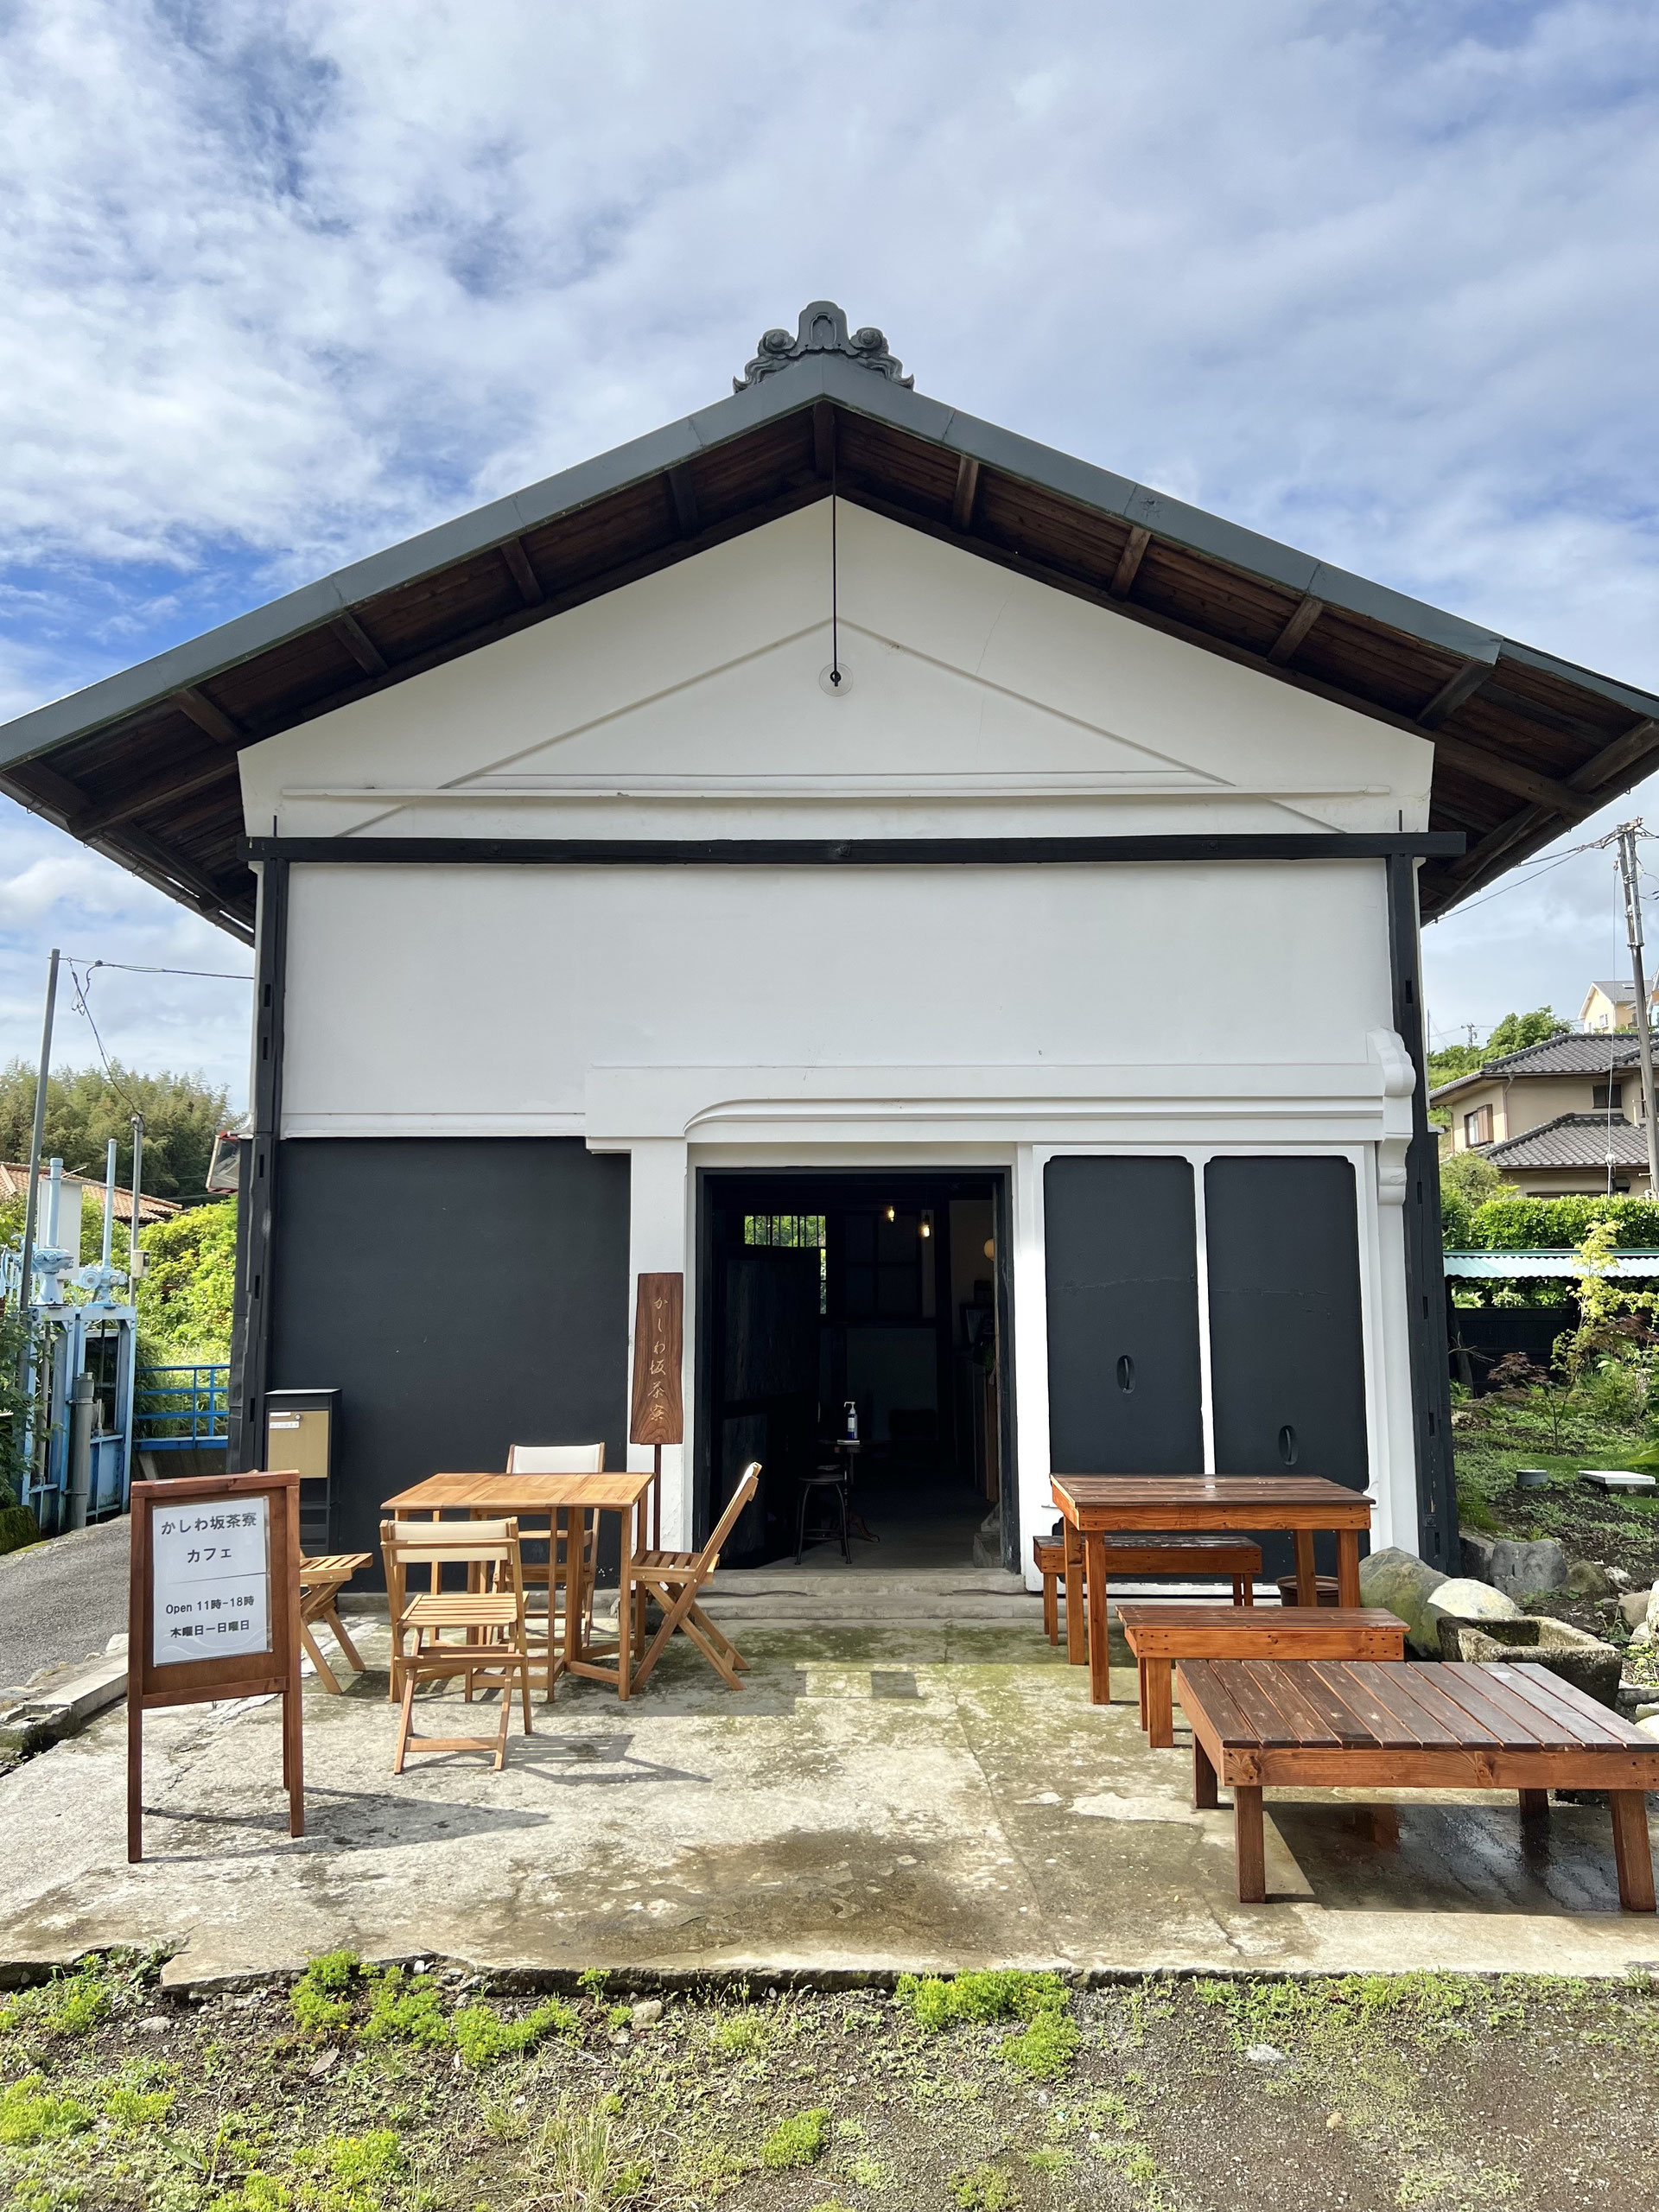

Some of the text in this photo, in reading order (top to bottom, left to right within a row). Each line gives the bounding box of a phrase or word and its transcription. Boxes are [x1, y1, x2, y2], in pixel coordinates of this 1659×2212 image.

[648, 1297, 668, 1421] かしわ坂茶寮
[162, 1512, 257, 1535] かしわ坂茶寮
[188, 1548, 232, 1563] カフェ
[166, 1602, 192, 1615] Open
